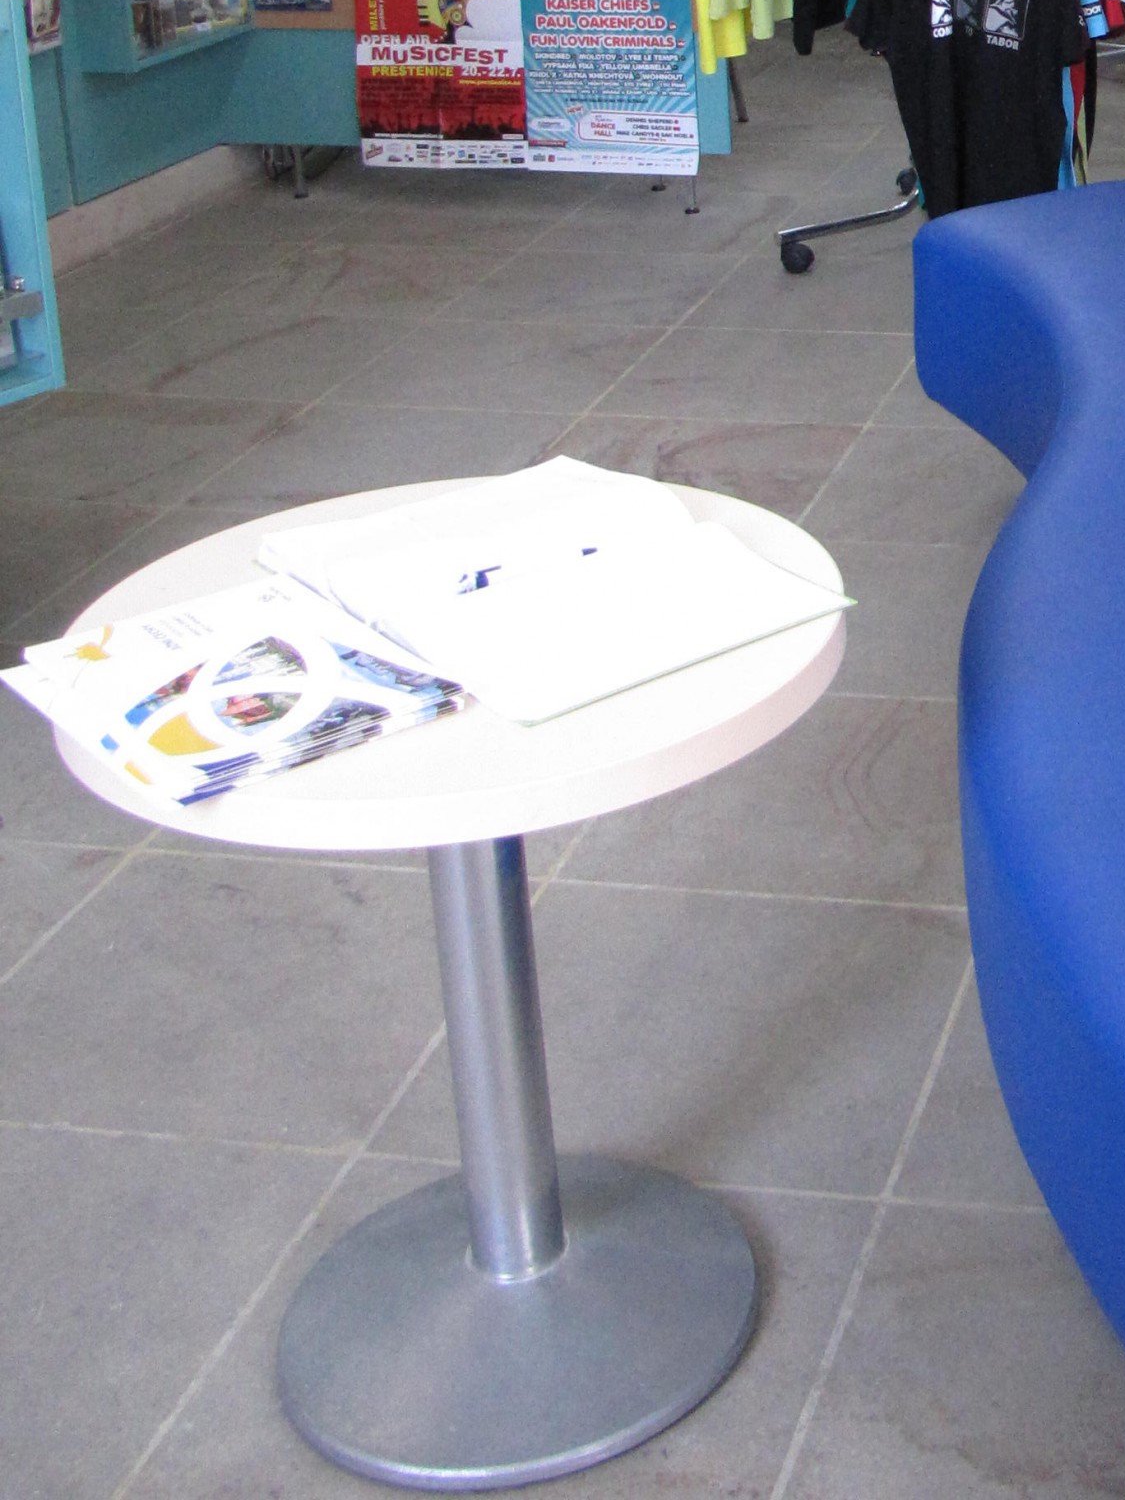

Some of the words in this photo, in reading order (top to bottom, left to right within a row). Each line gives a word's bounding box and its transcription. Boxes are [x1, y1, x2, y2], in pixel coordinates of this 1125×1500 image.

[547, 0, 597, 11] KAISER
[600, 0, 649, 11] CHIEFS
[536, 16, 574, 29] PAUL
[578, 16, 666, 30] OAKENFOLD
[360, 34, 401, 45] OPEN
[405, 34, 432, 45] AIR
[530, 35, 561, 46] FUN
[604, 36, 675, 47] CRIMINALS
[986, 34, 1020, 51] TABOR
[371, 46, 509, 65] MUSICFEST
